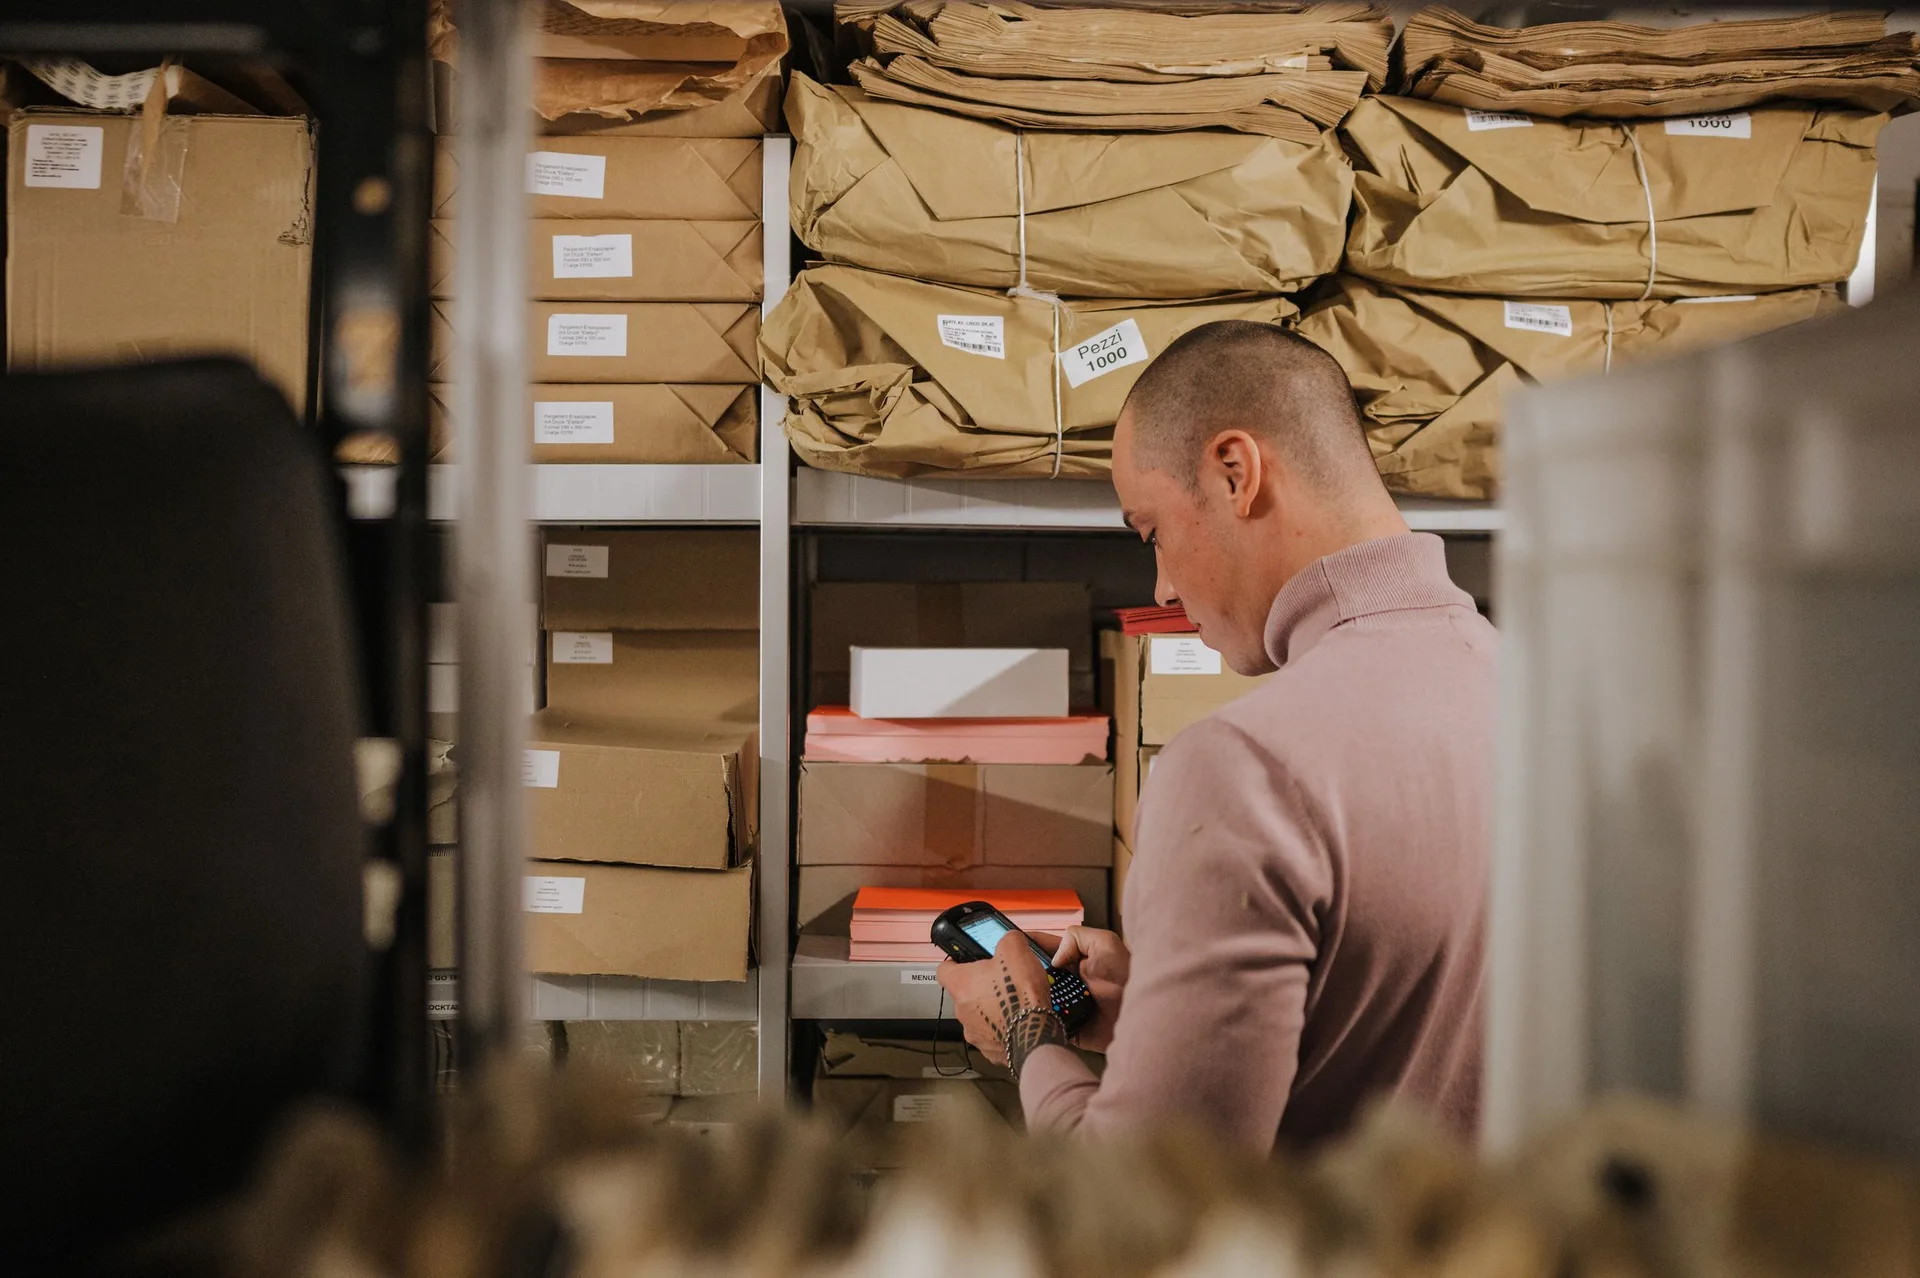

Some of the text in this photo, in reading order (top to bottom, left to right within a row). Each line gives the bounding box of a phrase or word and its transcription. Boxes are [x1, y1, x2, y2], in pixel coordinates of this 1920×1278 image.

[1688, 119, 1731, 129] 1000
[1077, 329, 1122, 359] Pezzi
[1087, 347, 1127, 371] 1000
